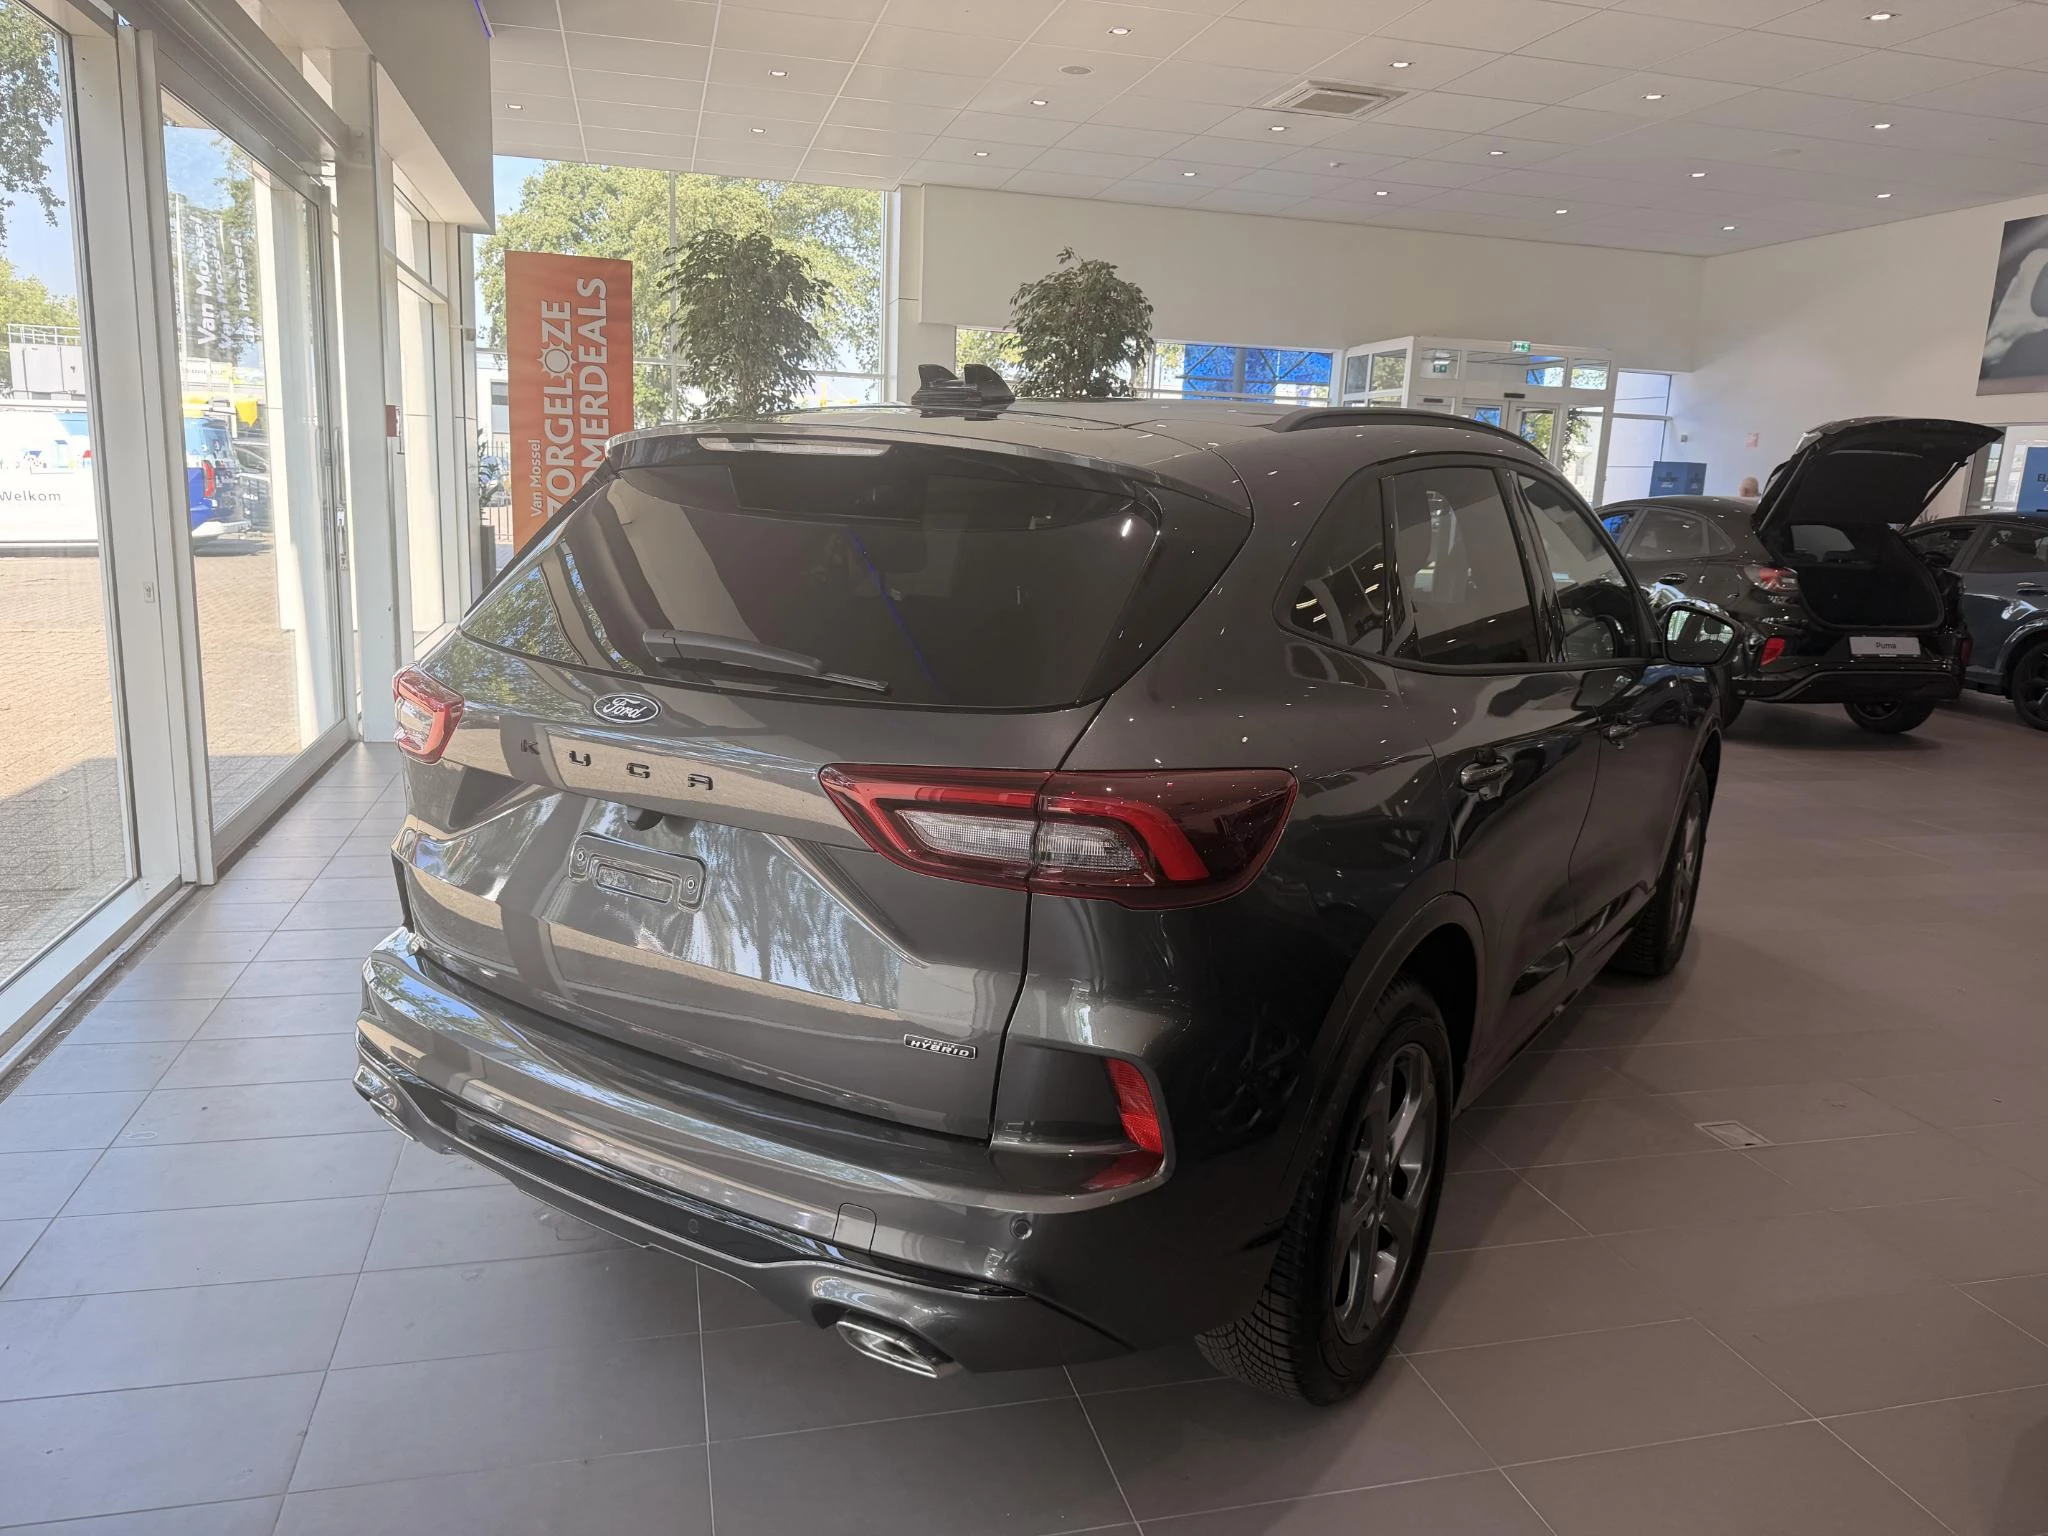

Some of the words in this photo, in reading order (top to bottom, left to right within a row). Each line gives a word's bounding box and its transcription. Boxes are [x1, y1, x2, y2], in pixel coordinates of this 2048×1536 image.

[188, 215, 213, 297] Mossel
[197, 302, 217, 345] Van
[576, 278, 609, 486] MERDEALS
[528, 439, 543, 482] Mossel
[0, 490, 61, 502] Welkom
[528, 485, 544, 518] Van
[602, 697, 647, 719] Ford
[520, 739, 714, 791] KUGA
[910, 1040, 970, 1057] HYBRID
